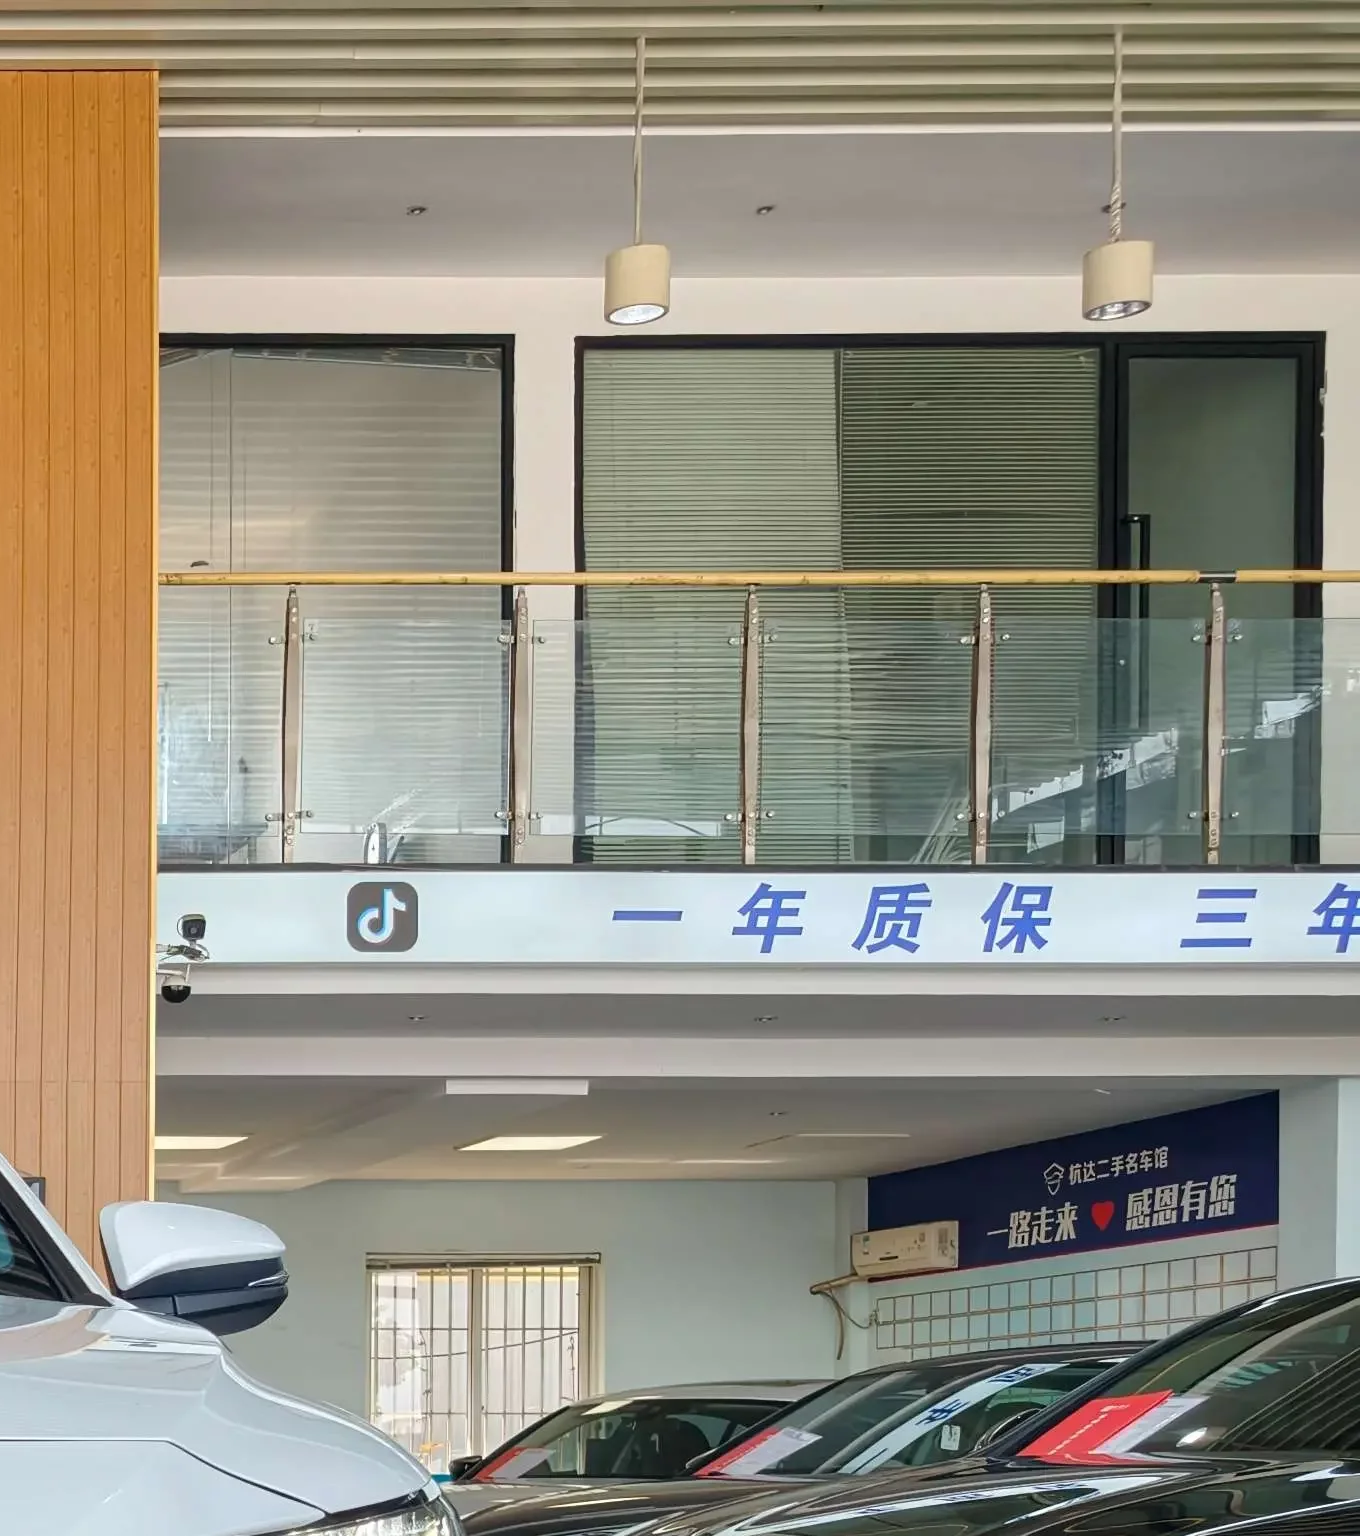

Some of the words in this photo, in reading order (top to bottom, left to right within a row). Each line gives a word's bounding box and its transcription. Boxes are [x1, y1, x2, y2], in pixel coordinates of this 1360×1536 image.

[612, 882, 1053, 954] 一年质保
[1068, 1146, 1169, 1186] 杭达二手名车馆
[986, 1202, 1078, 1249] 一路走来
[1125, 1174, 1237, 1232] 感恩有您
